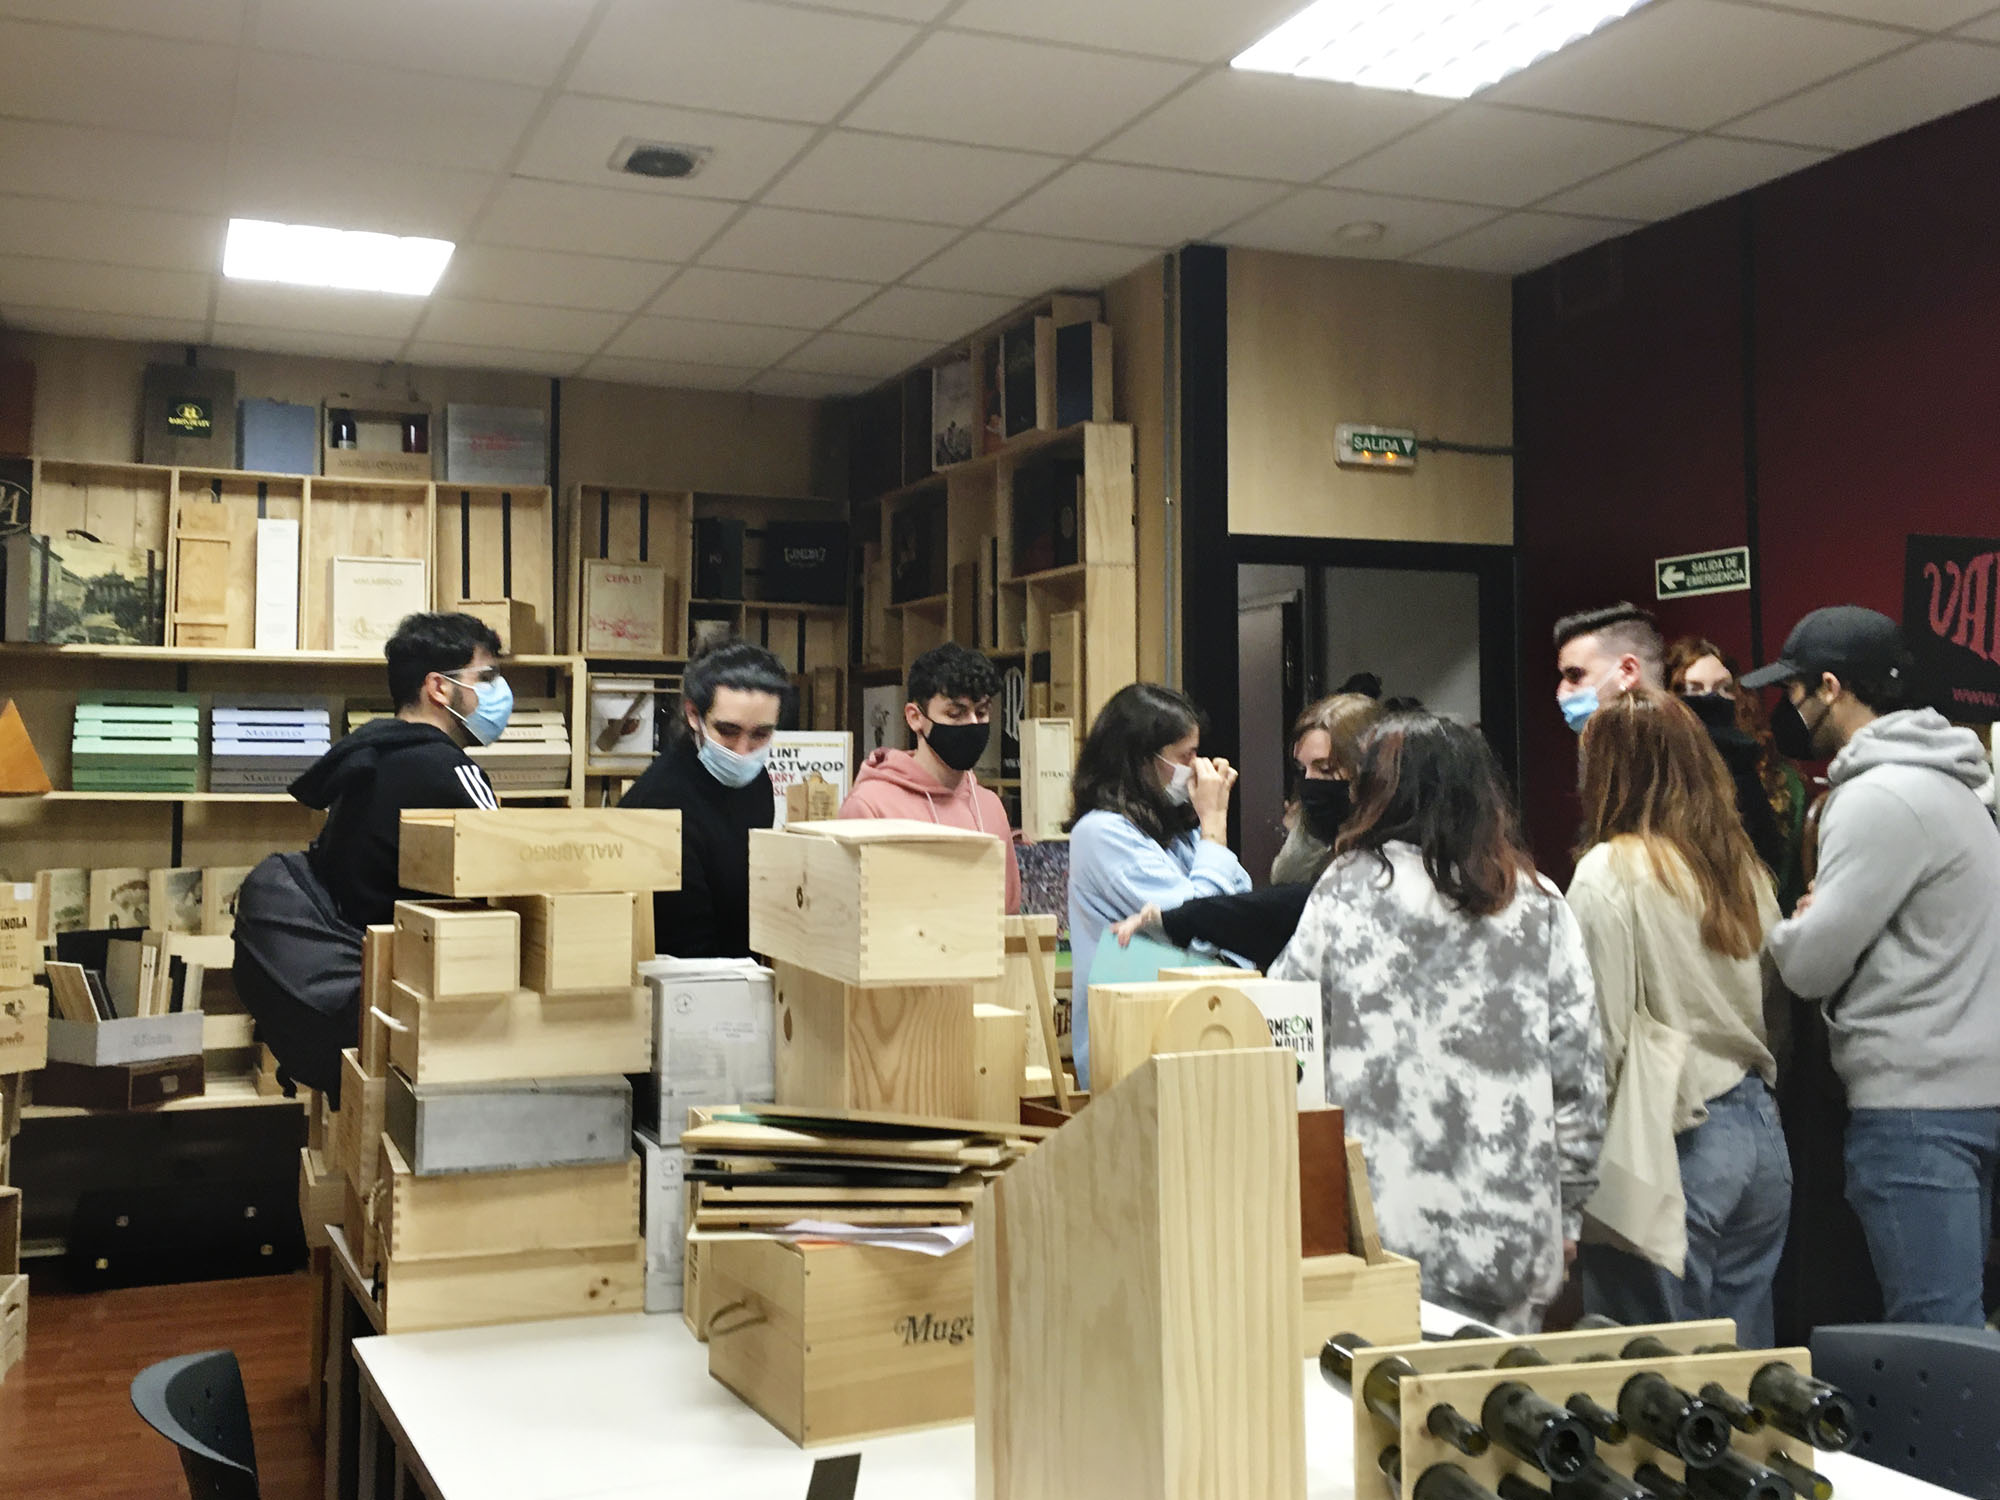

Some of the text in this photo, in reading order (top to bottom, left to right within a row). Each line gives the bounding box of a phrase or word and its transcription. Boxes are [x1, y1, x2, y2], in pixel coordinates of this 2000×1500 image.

[1353, 435, 1400, 452] SALIDA
[1691, 555, 1738, 574] SALIDA DE
[1685, 569, 1745, 587] EMERGENCIA
[1923, 553, 2000, 666] VA
[768, 748, 800, 758] LINT
[767, 761, 844, 772] ASTWOOD
[768, 773, 794, 783] ARRY
[520, 843, 624, 862] MALABRIGO
[1267, 1016, 1313, 1036] RMEON
[1275, 1037, 1315, 1053] MOUTH
